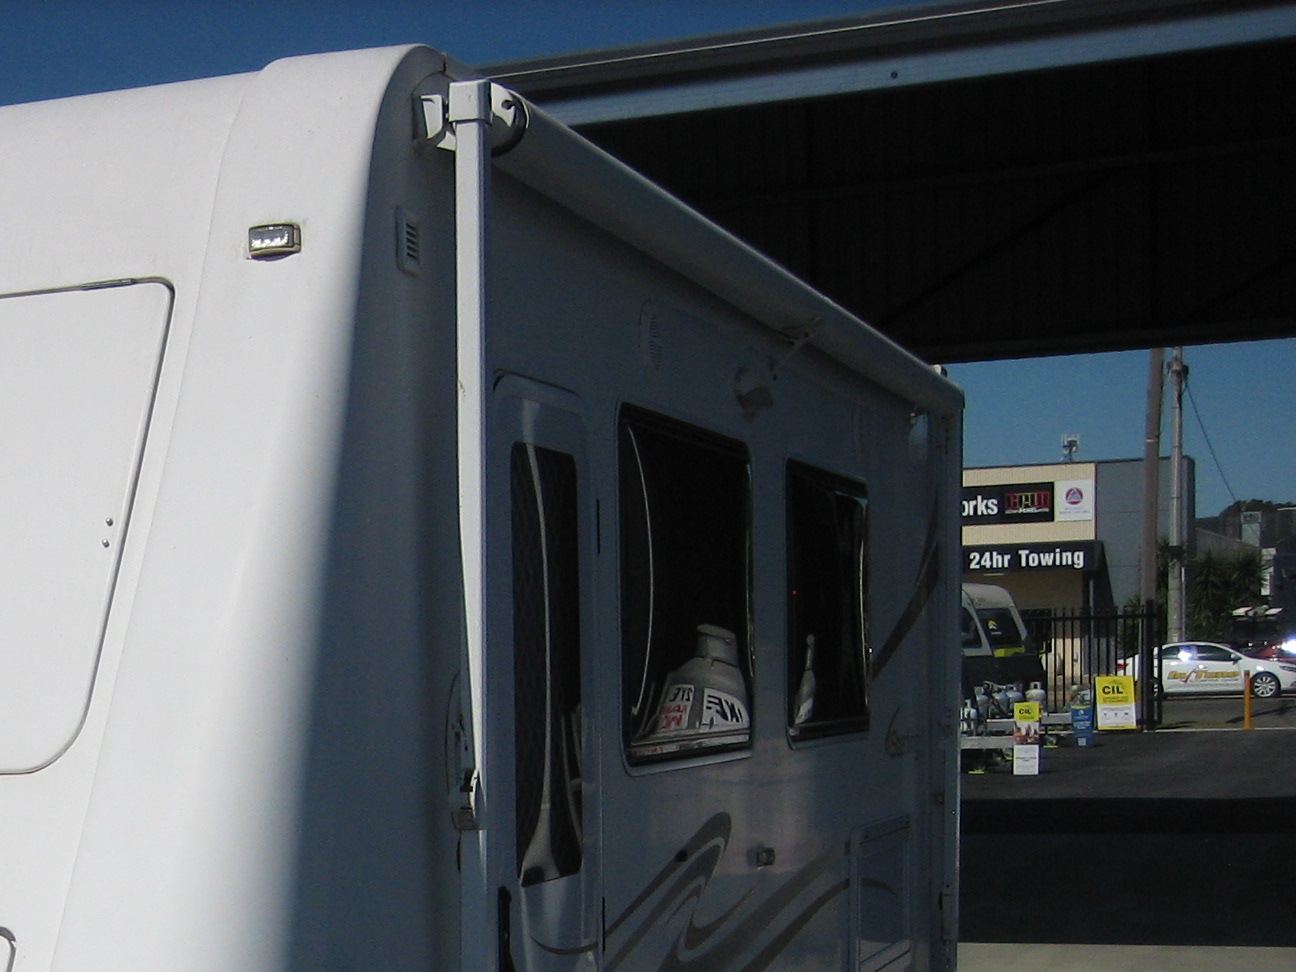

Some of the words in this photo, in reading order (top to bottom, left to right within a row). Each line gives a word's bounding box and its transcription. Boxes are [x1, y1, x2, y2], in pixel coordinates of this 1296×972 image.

[969, 551, 1012, 570] 24hr
[1018, 548, 1085, 569] Towing
[1102, 685, 1124, 695] CIL
